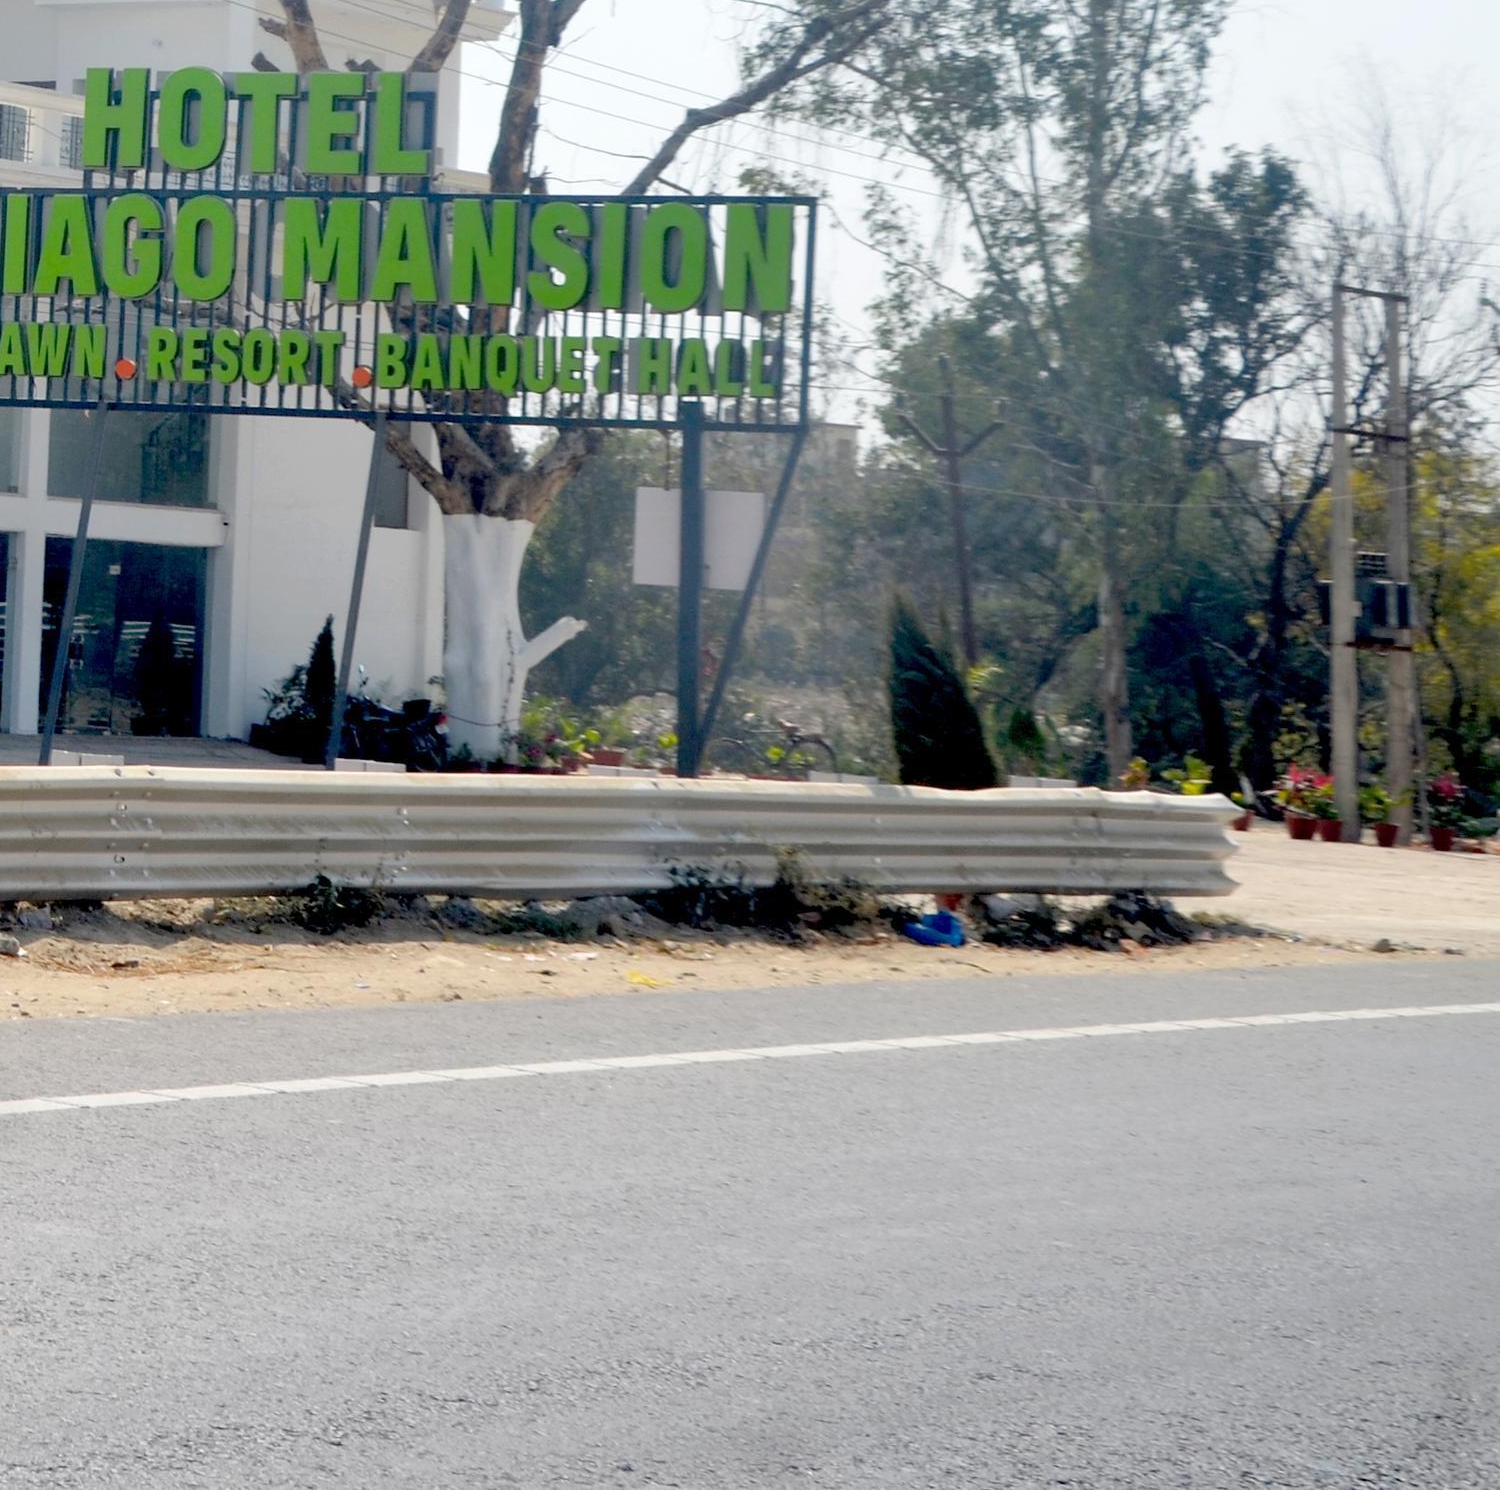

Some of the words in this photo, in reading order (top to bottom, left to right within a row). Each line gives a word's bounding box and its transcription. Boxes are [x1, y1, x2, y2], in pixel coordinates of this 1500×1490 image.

[82, 67, 430, 175] HOTEL
[281, 197, 793, 312] MANSION
[146, 325, 344, 387] RESORT
[376, 333, 620, 397] BANQUET
[637, 338, 776, 398] HALL
